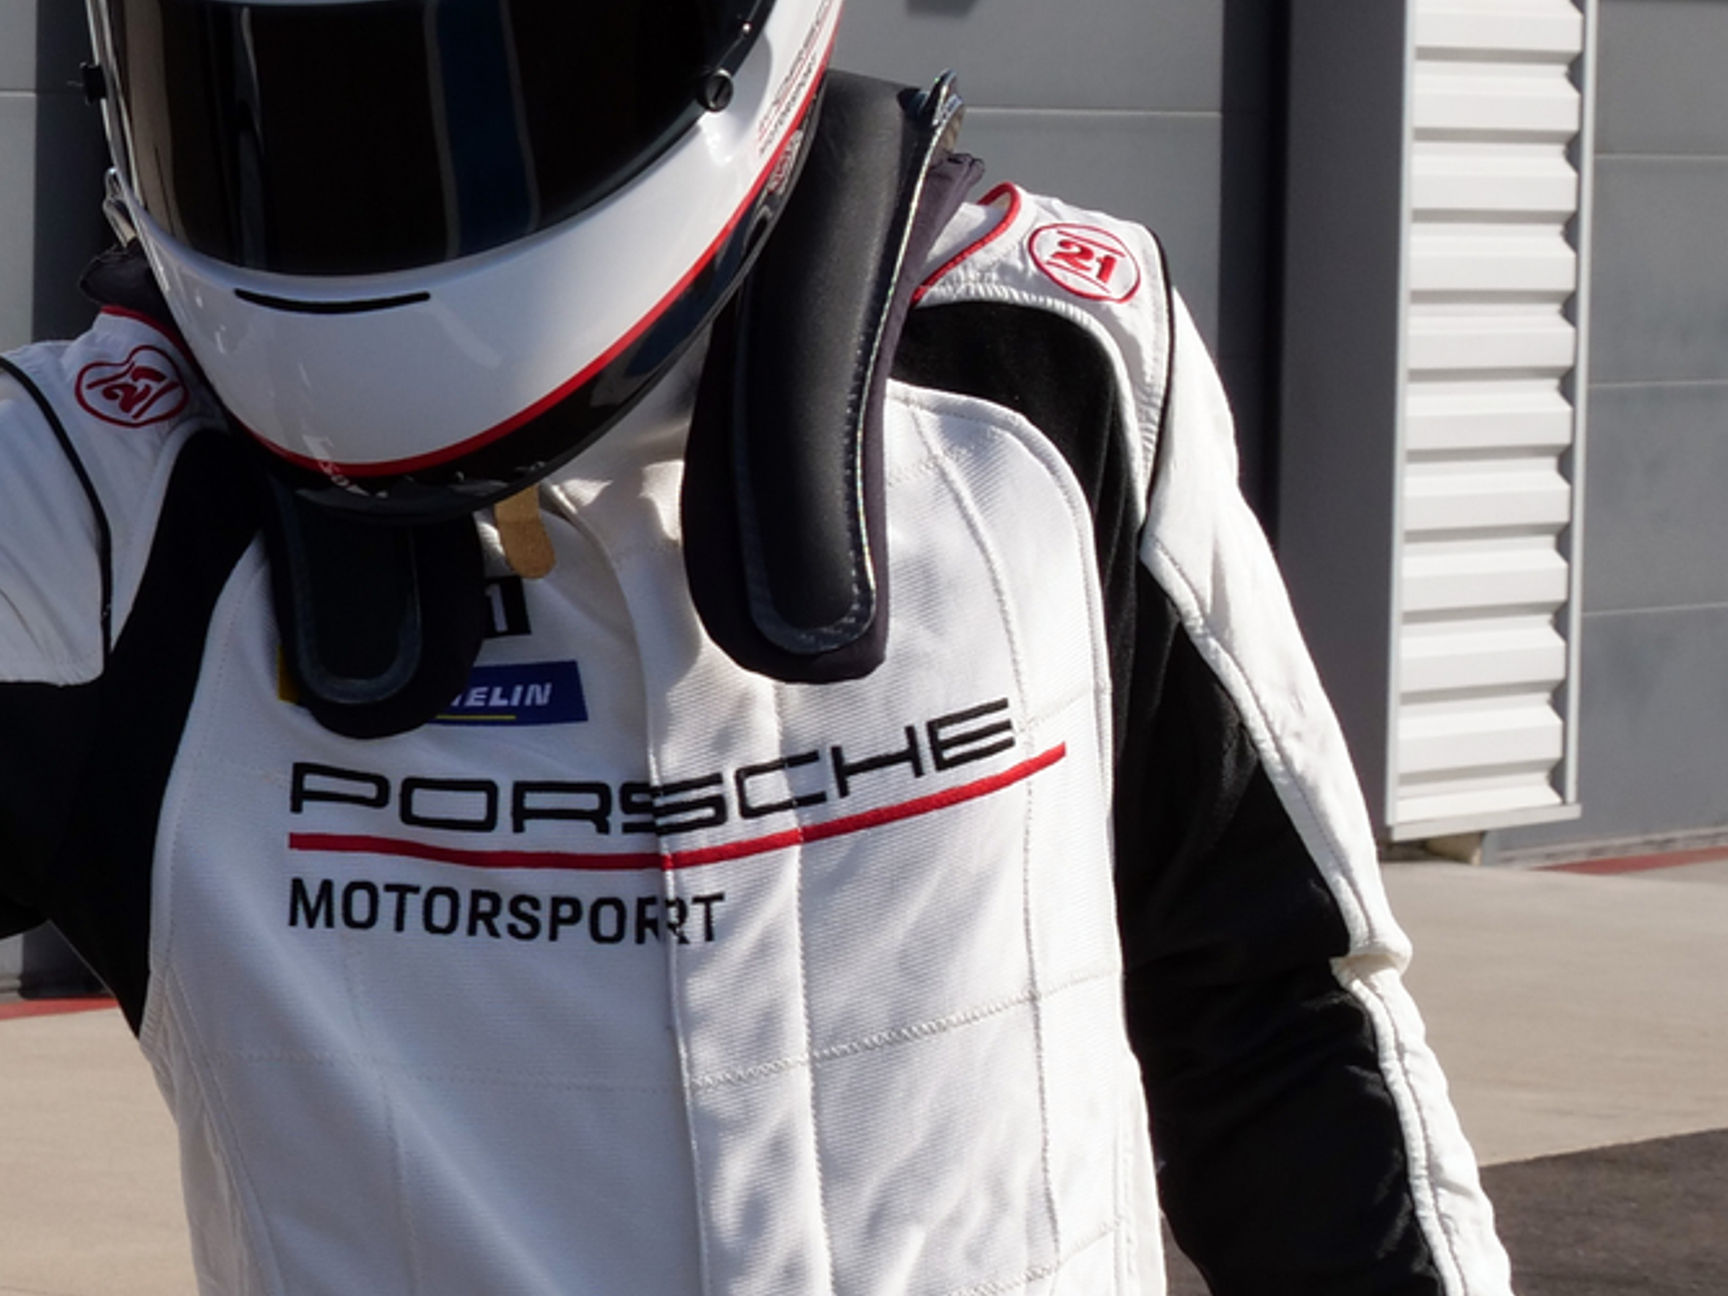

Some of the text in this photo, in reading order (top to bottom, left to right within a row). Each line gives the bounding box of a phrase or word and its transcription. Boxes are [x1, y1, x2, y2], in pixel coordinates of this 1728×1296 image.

[1052, 238, 1118, 284] 21
[289, 698, 1016, 835] PORSCHE
[288, 878, 725, 945] MOTORSPORT
